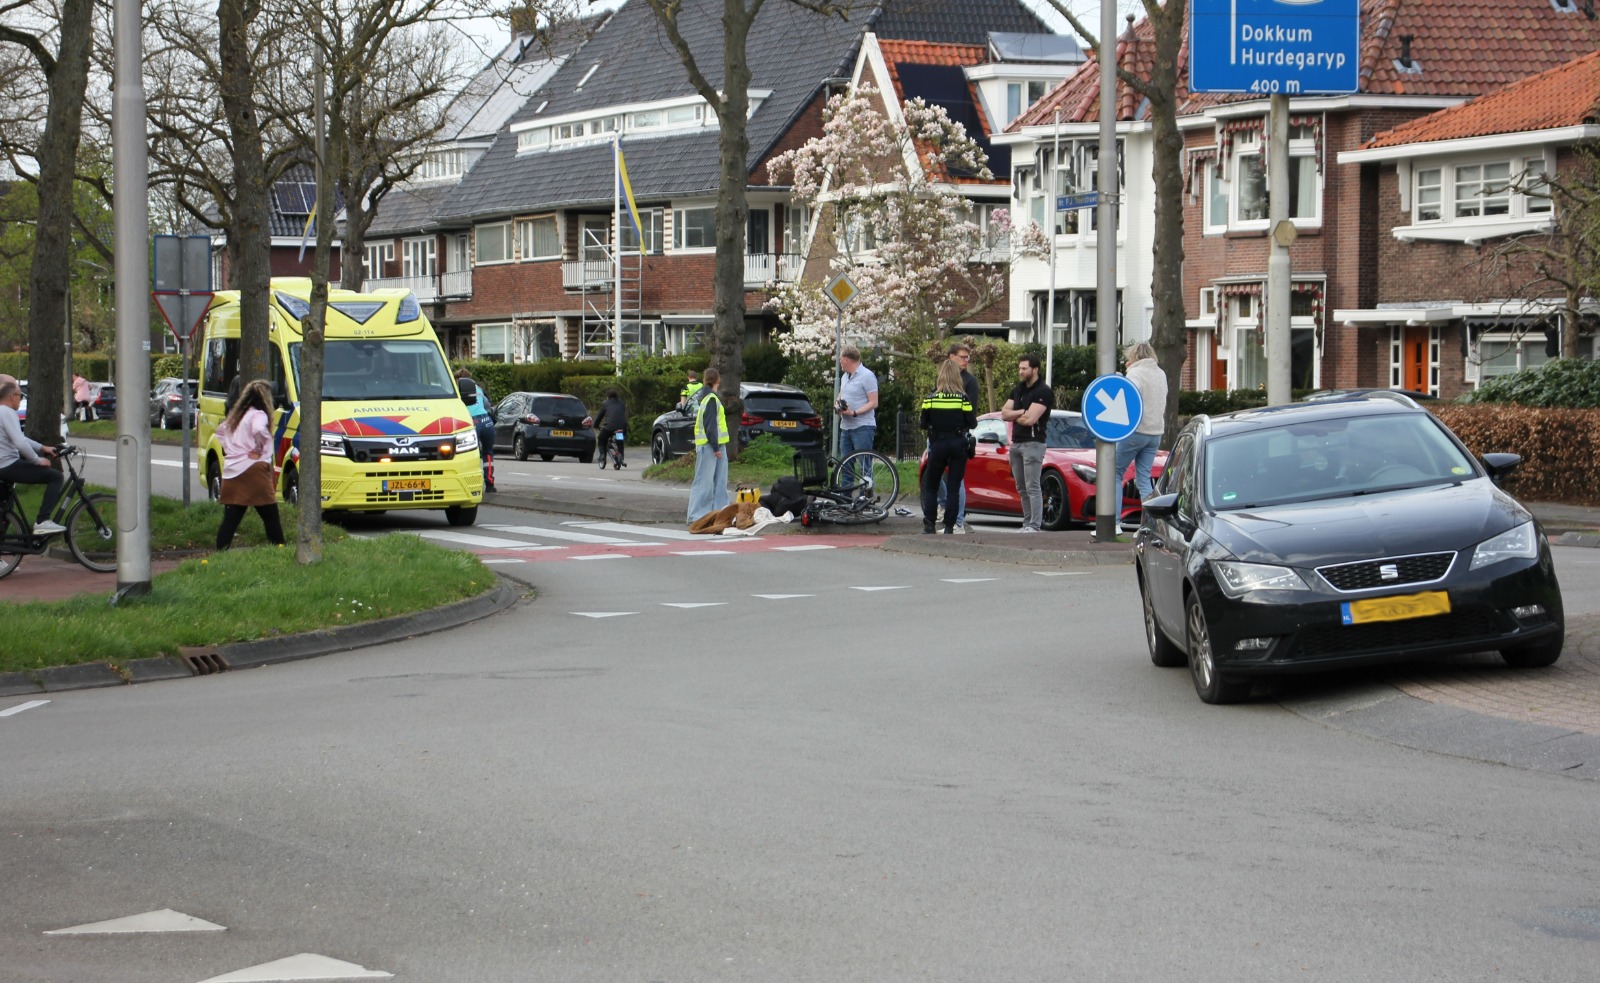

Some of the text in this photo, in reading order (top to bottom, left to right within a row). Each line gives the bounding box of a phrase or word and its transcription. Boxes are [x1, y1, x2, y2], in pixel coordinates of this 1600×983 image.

[1242, 24, 1312, 42] Dokkum
[1241, 48, 1346, 71] Hurdegaryp
[1250, 79, 1300, 93] 400 m
[353, 406, 430, 414] AMBULANCE
[390, 480, 426, 489] JZL-66-K
